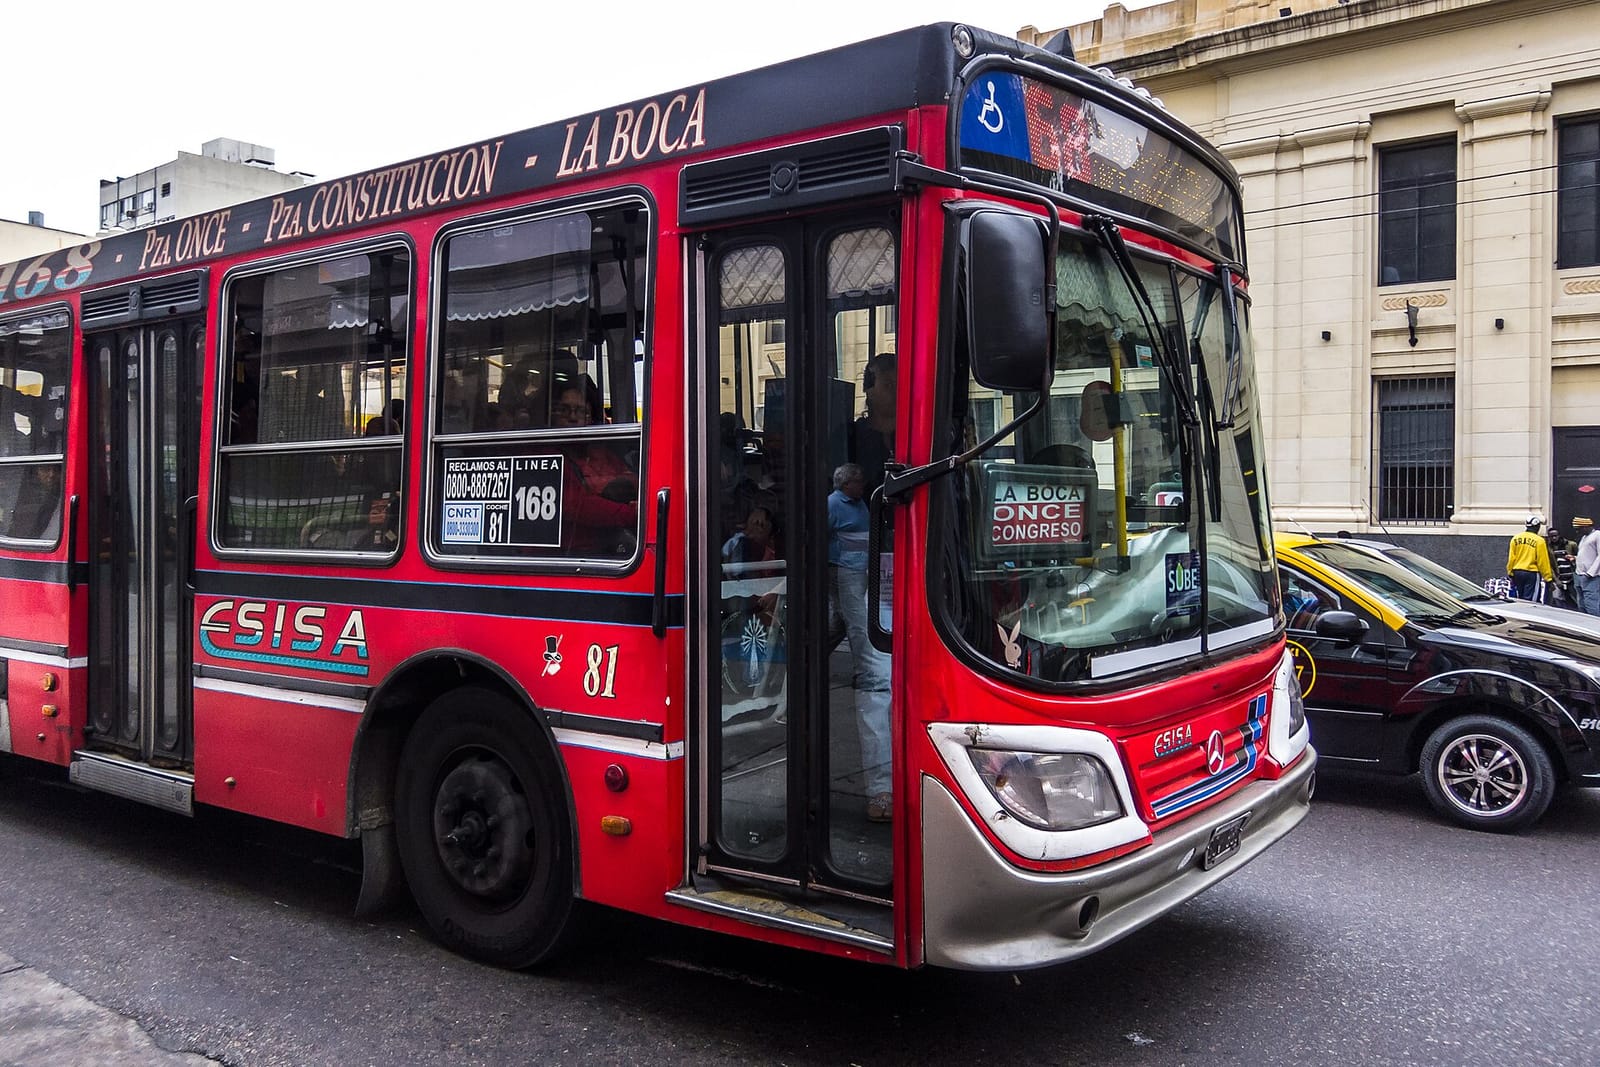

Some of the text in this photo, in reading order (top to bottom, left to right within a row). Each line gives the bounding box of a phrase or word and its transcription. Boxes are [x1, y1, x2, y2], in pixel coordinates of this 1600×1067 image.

[0, 242, 101, 302] 168
[175, 210, 231, 262] ONCE
[306, 140, 504, 233] CONSTITUCION
[556, 115, 600, 179] LA
[605, 87, 706, 167] BOCA
[448, 461, 509, 472] RECLAMOS AL
[515, 460, 559, 470] LINEA
[446, 472, 509, 499] 0800-8887267
[995, 485, 1081, 501] A BOCA
[447, 507, 480, 518] CNRT
[485, 503, 508, 511] COCHE
[515, 486, 556, 520] 168
[993, 503, 1081, 522] ONCE
[489, 512, 503, 543] 81
[992, 521, 1081, 541] CONGRESO
[1168, 563, 1198, 593] SUBE
[201, 601, 369, 677] ESISA
[584, 644, 621, 699] 81
